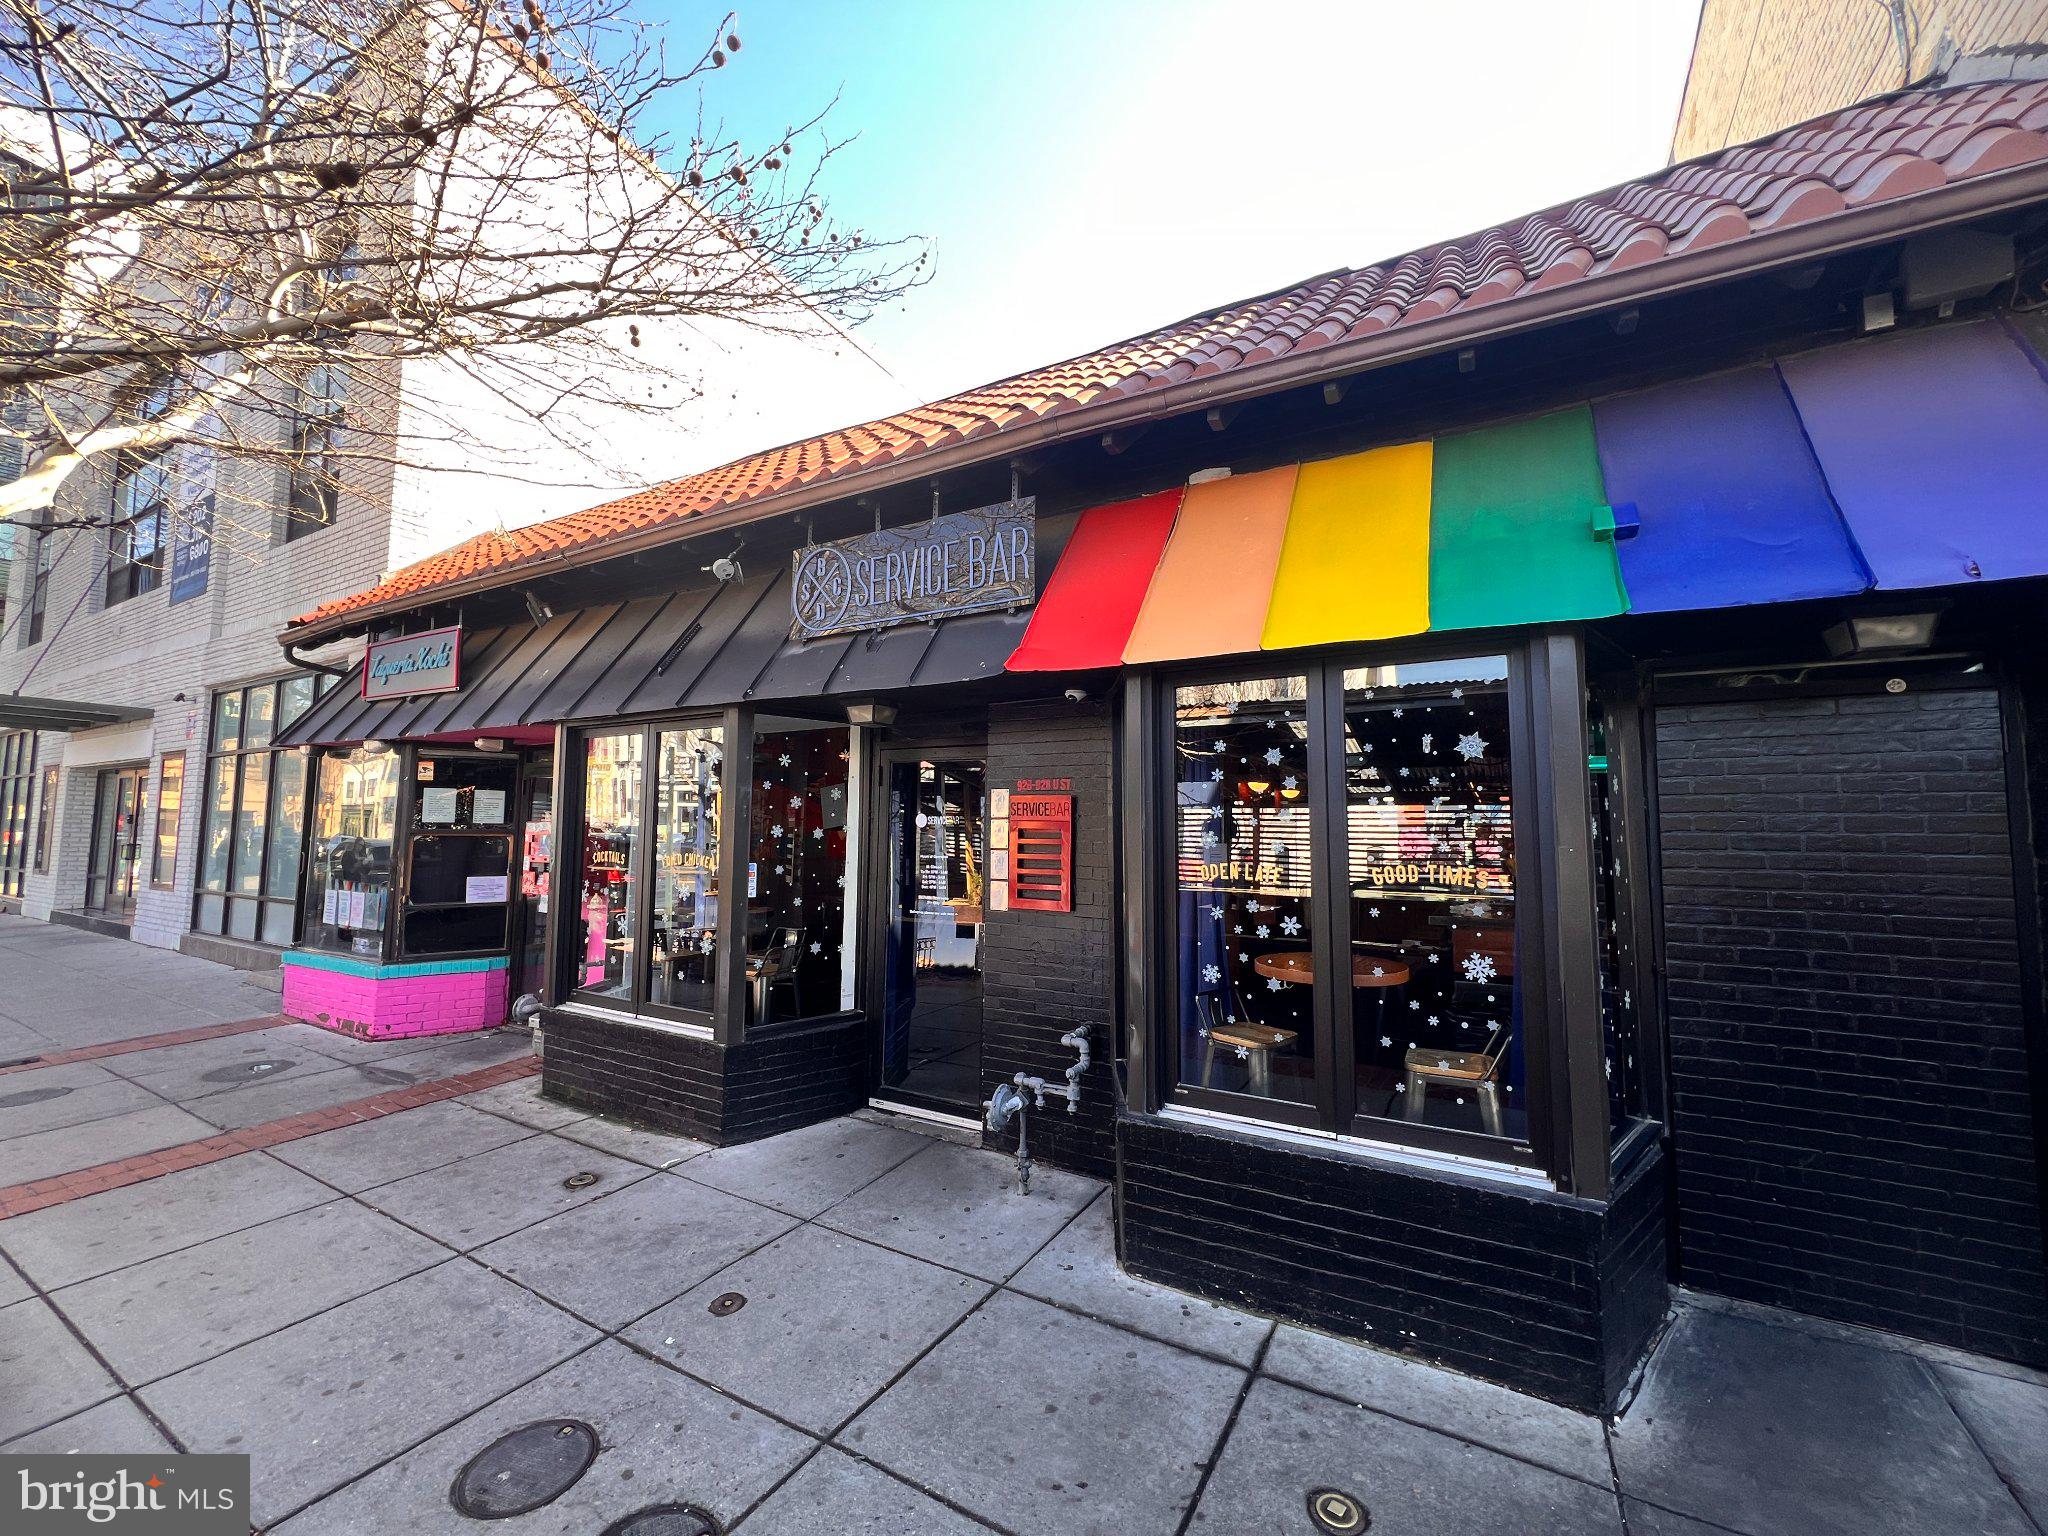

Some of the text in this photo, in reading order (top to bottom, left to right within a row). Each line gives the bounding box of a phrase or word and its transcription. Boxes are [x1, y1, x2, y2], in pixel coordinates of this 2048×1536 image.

[816, 557, 826, 577] B
[855, 527, 1029, 608] SERVICE BAR
[801, 583, 810, 601] S
[832, 577, 842, 597] C
[816, 603, 826, 621] D
[414, 642, 452, 671] Xochi
[1010, 802, 1070, 817] SERVICEBAR
[593, 850, 626, 865] COCKTAILS
[1201, 861, 1284, 885] OPEN LATE
[1371, 864, 1490, 889] GOOD TIMES
